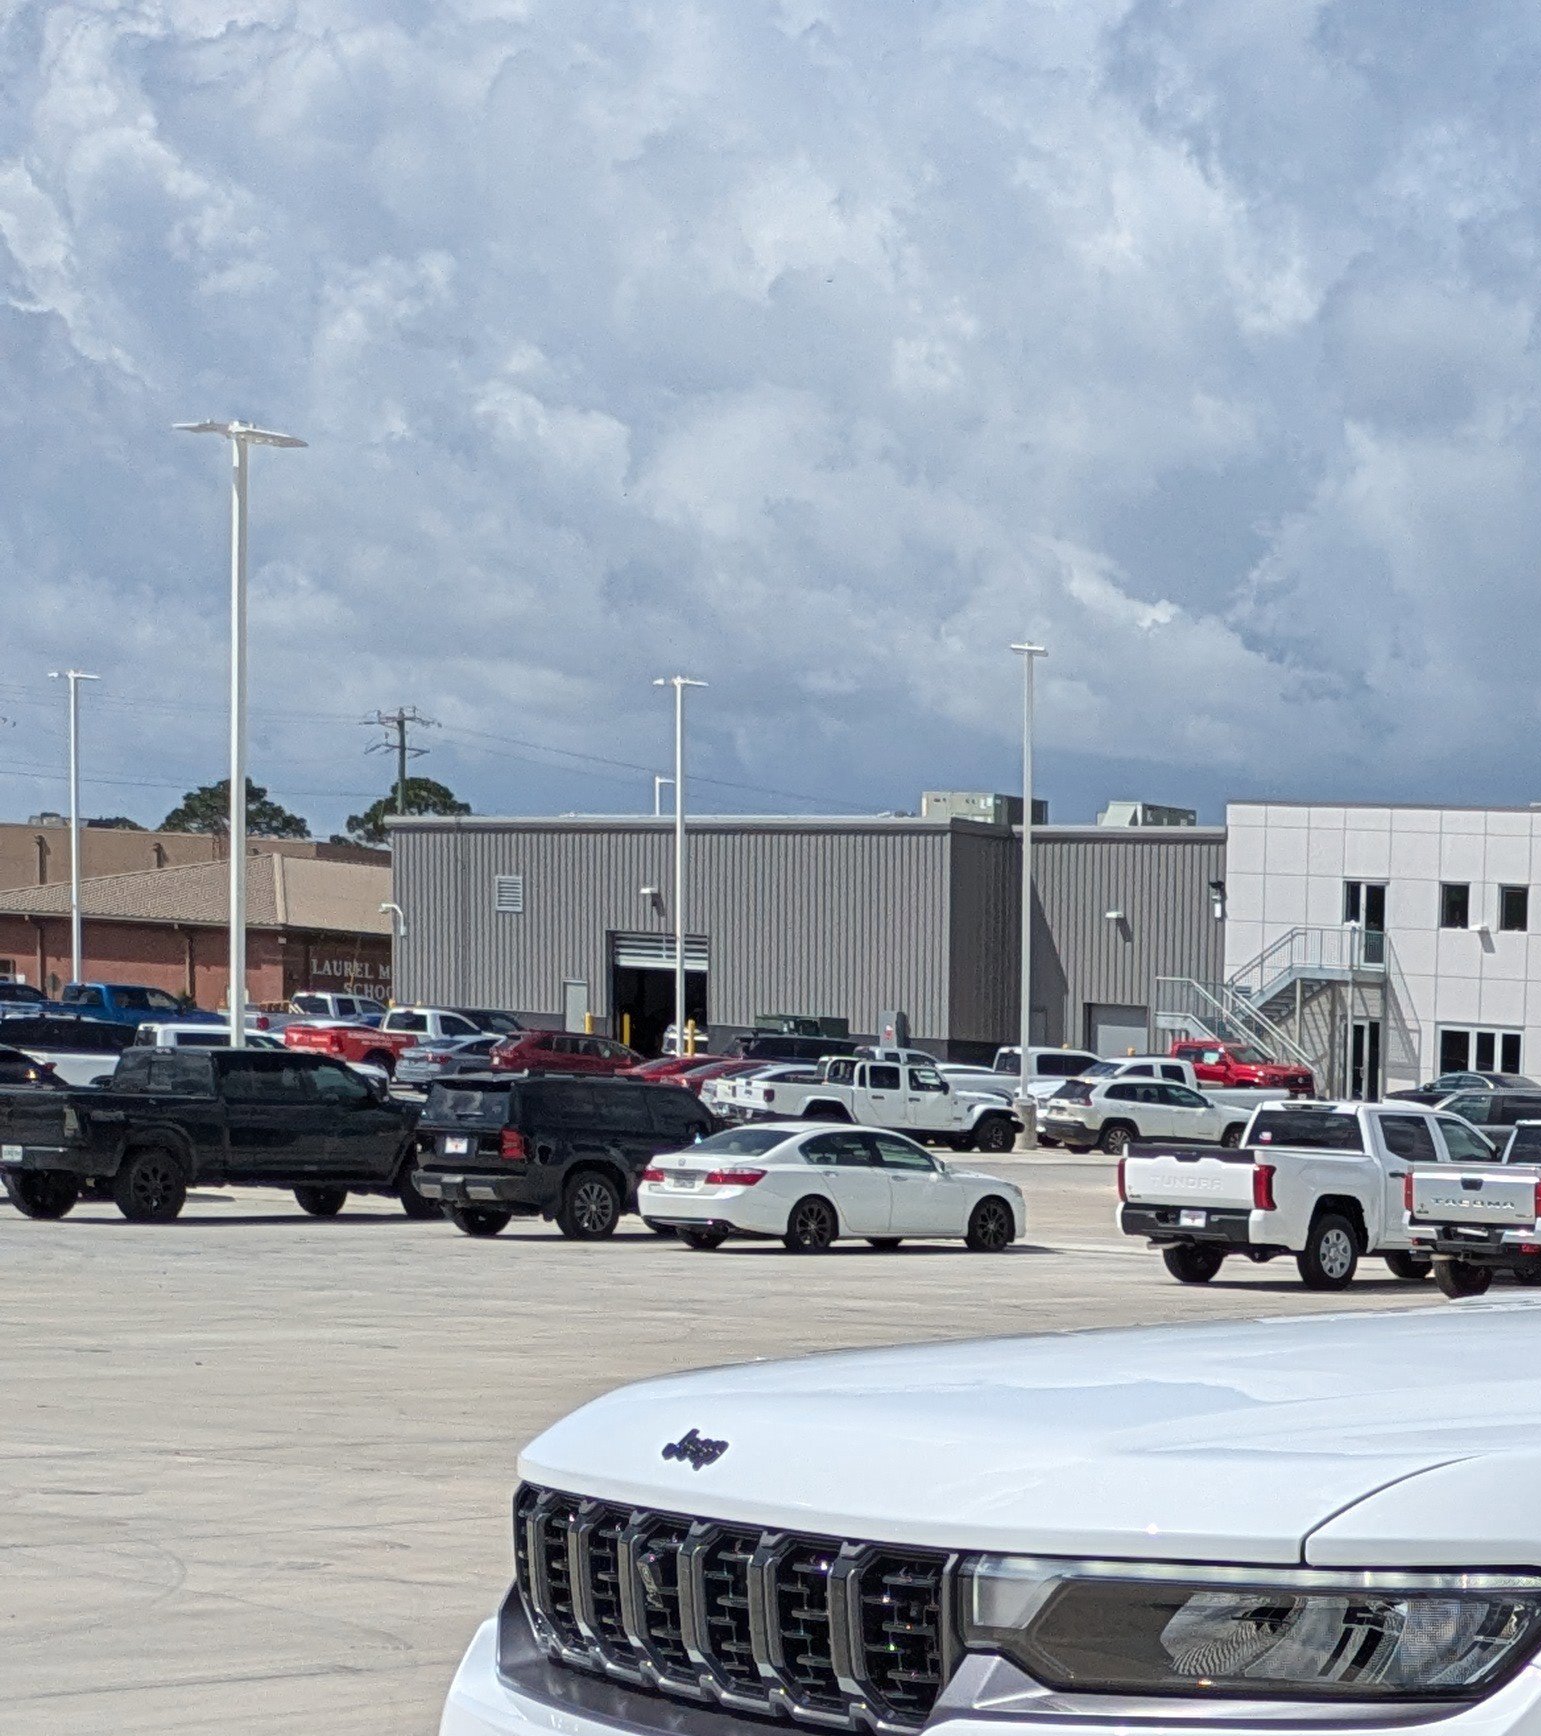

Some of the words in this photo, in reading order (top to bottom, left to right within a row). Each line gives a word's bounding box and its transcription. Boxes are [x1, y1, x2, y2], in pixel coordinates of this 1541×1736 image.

[311, 959, 374, 979] LAUREL
[1150, 1175, 1224, 1191] TUNDRA
[1431, 1197, 1515, 1209] TACOMA
[661, 1428, 729, 1471] Jeep
